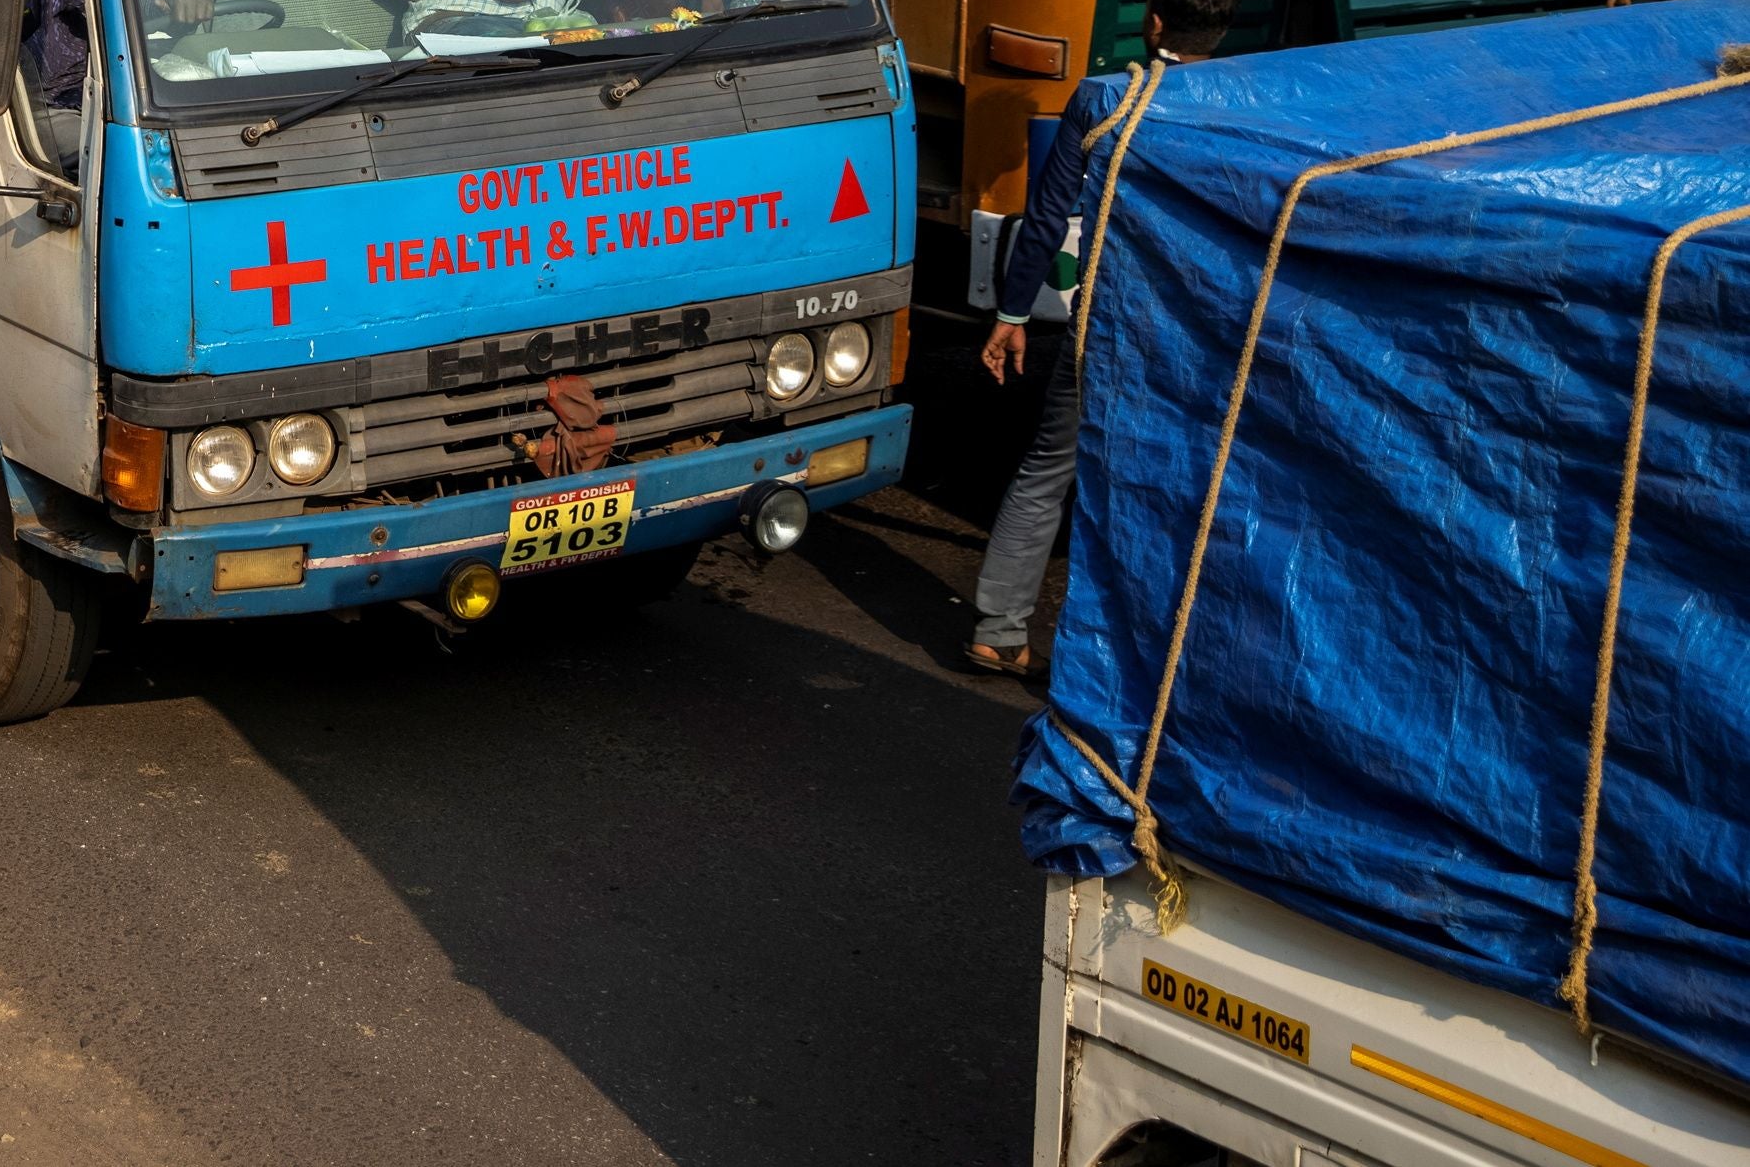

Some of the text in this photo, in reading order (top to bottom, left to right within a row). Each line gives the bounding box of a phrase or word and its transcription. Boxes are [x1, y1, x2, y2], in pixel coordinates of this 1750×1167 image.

[458, 146, 691, 214] GOVT. VEHICLE
[367, 225, 531, 284] HEALTH
[547, 220, 575, 261] &
[796, 289, 858, 320] 10.70
[427, 307, 712, 392] EICHER
[515, 482, 631, 511] GOVT. OF ODISHA
[525, 497, 619, 532] OR 10 B
[501, 547, 619, 576] HEALTH & FW DEPTT.
[510, 521, 624, 562] 5103
[1147, 967, 1305, 1057] OD 02 AJ 1064
